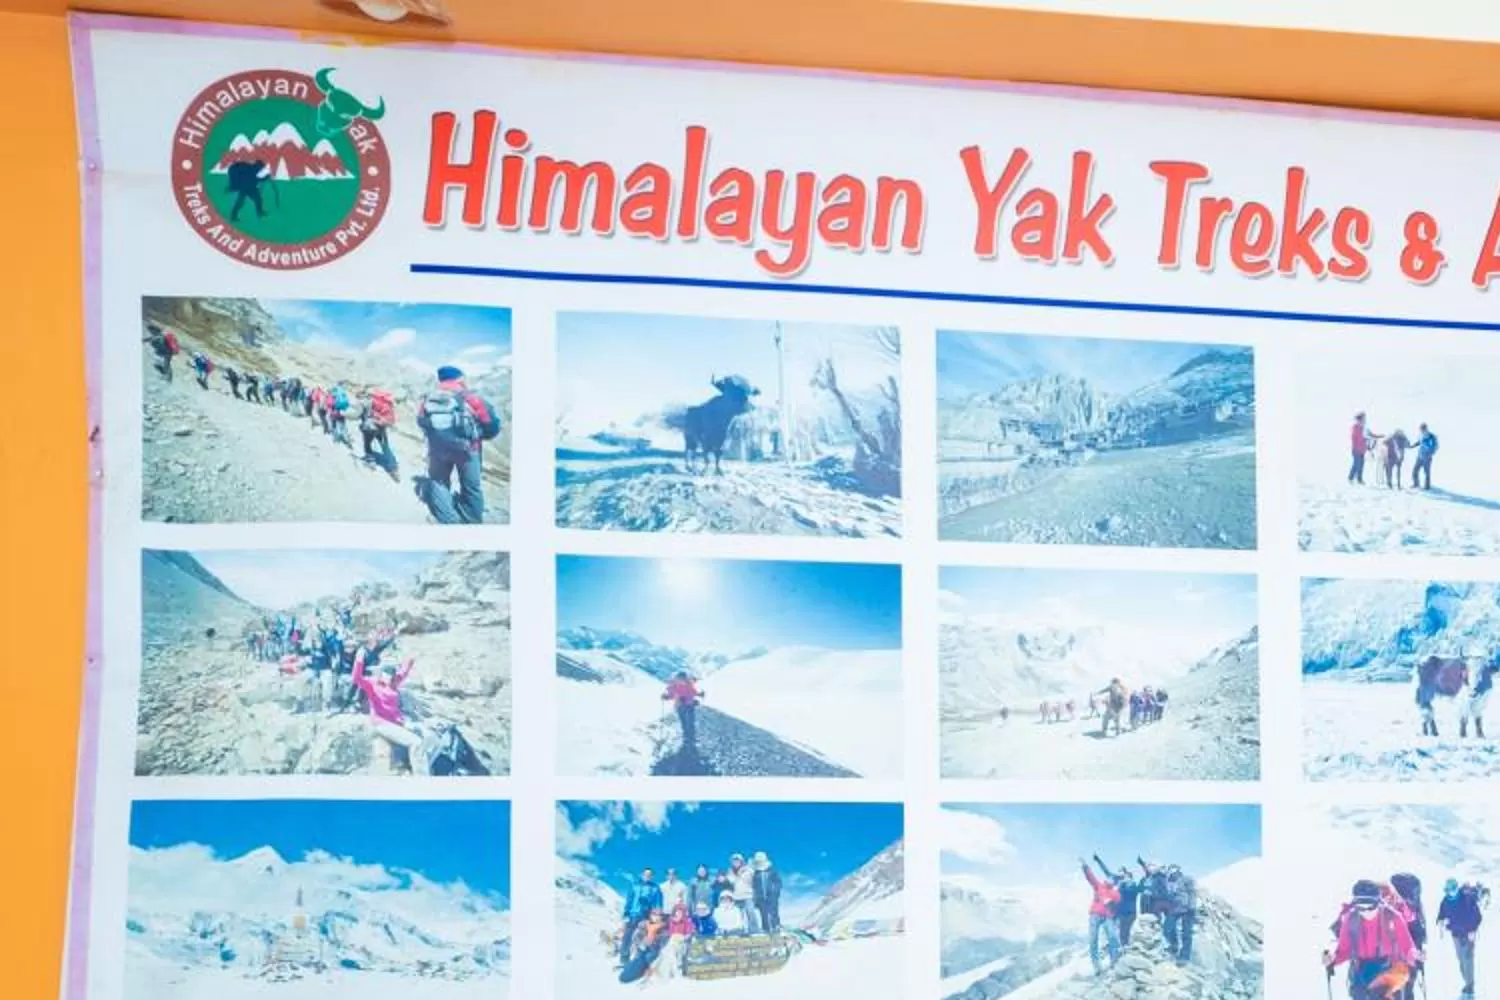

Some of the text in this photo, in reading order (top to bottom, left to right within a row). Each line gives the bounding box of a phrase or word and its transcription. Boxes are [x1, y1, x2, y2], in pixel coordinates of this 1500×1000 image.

[179, 76, 309, 150] Himalayan
[183, 182, 381, 266] Treks And Adventure Pvt. Ltd.
[421, 108, 926, 275] Himalayan
[957, 144, 1114, 264] Yak
[1148, 159, 1371, 278] Treks
[1399, 210, 1446, 284] &
